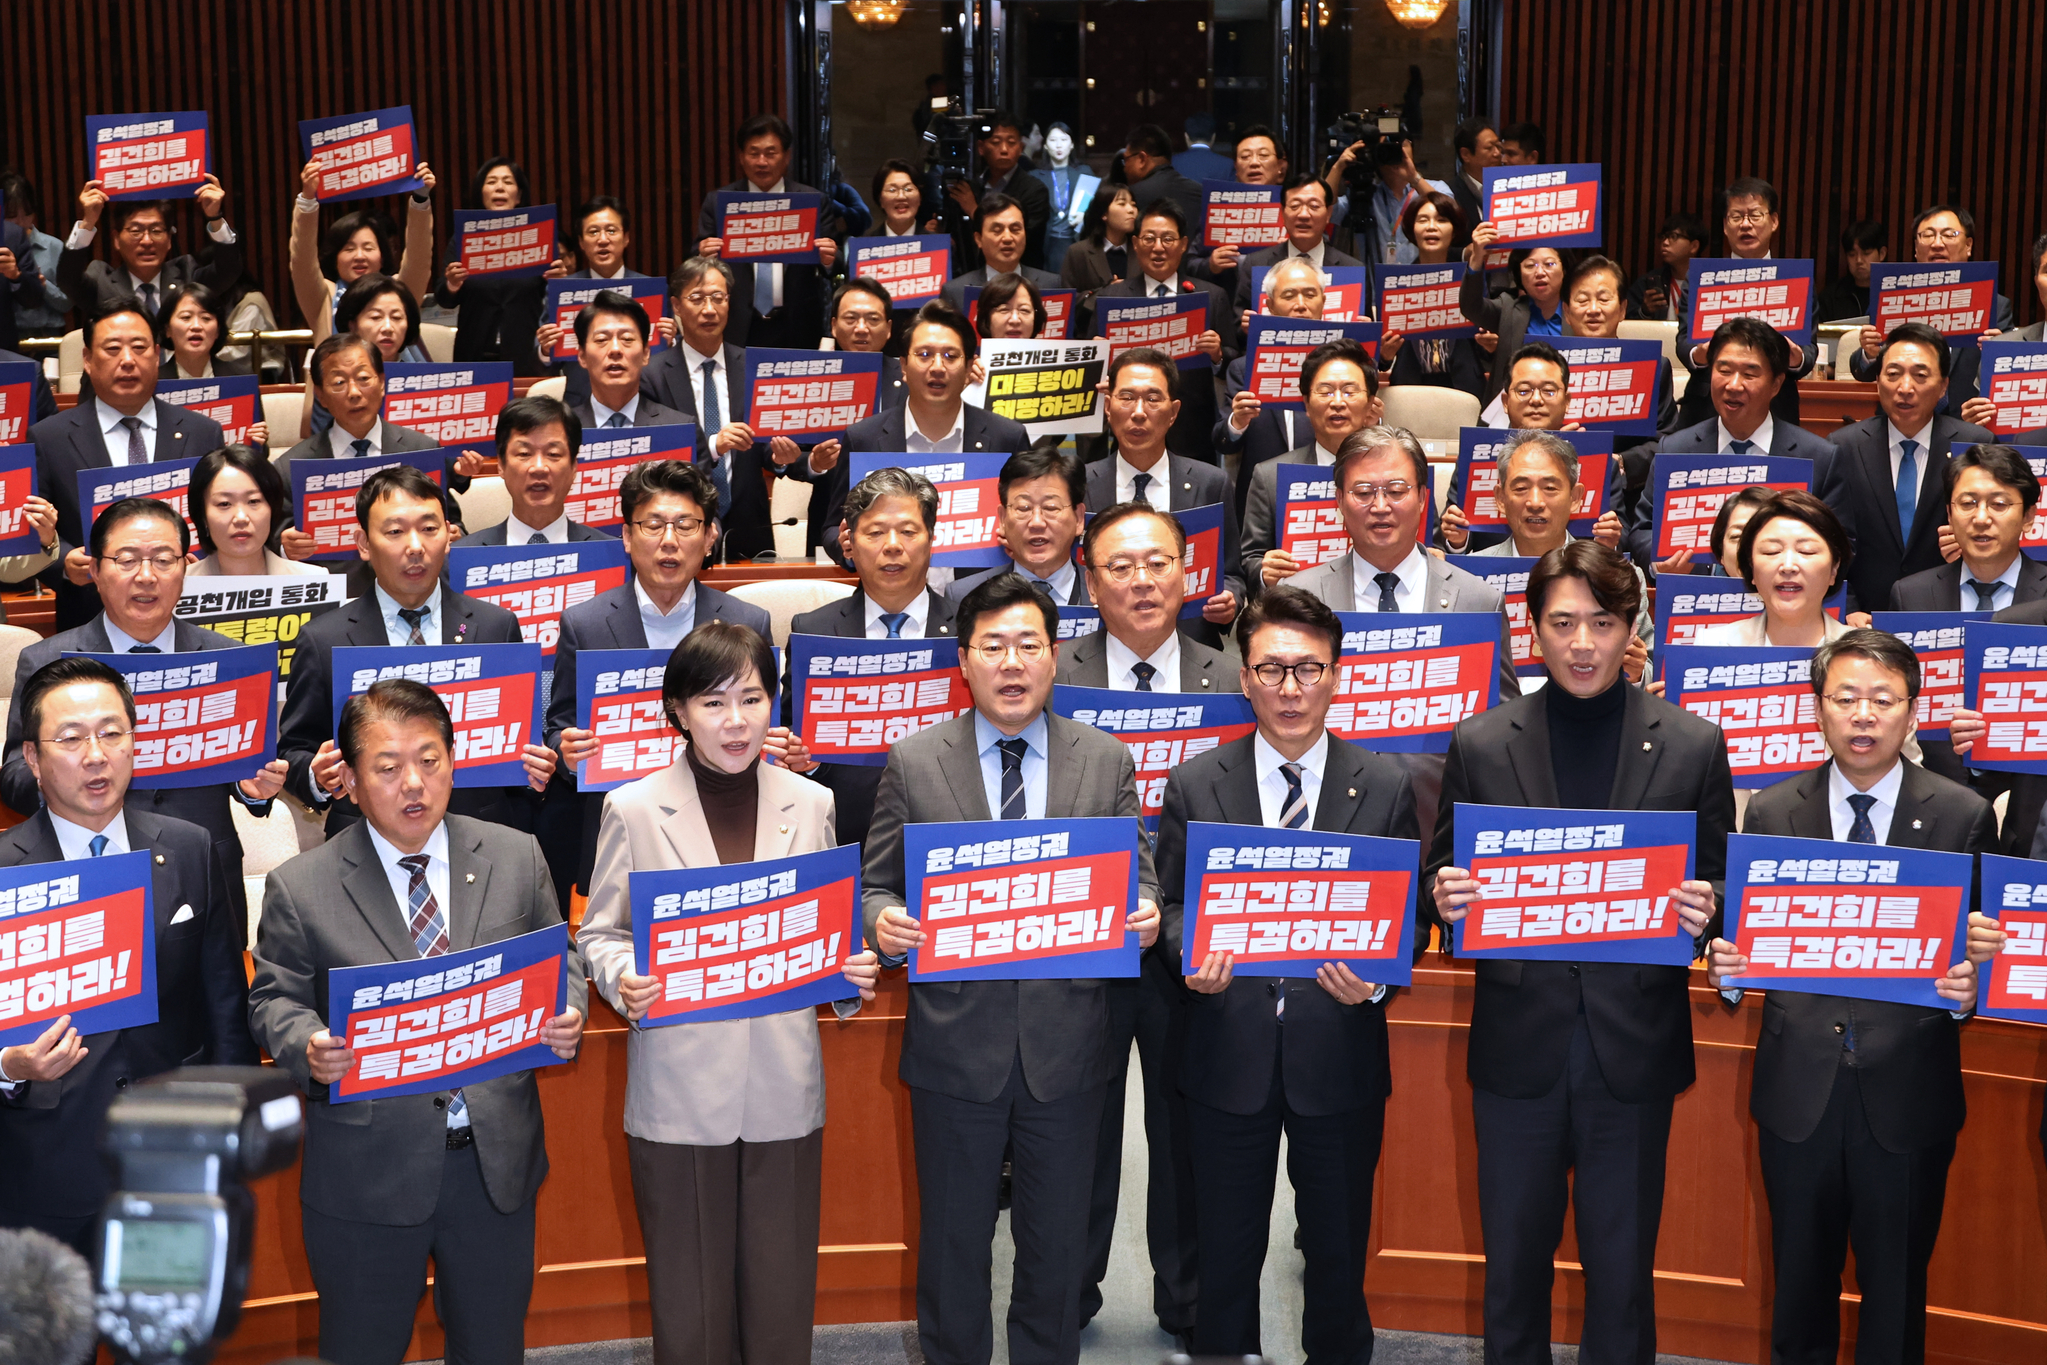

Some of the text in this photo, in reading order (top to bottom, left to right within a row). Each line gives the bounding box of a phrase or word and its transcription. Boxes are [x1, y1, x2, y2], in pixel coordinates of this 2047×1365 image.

[97, 120, 174, 142] 윤석열정권
[310, 118, 378, 146] 윤석열정권
[99, 138, 186, 169] 김건희를
[103, 159, 200, 190] 특검하라!
[322, 154, 407, 191] 특검하라!
[1493, 170, 1567, 192] 윤석열정권
[726, 199, 790, 213] 윤석열정권
[1209, 191, 1271, 203] 윤석열정권
[1494, 189, 1577, 217] 김건희를
[463, 214, 528, 232] 윤석열정권
[726, 214, 800, 235] 김건희를
[1209, 207, 1279, 224] 김건희를
[1497, 210, 1589, 238] 특검하라!
[464, 228, 538, 253] 김건희를
[729, 232, 809, 253] 특검하라!
[857, 241, 921, 260] 윤석열정권
[469, 244, 548, 270] 특검하라!
[880, 274, 942, 298] 검하라!
[1385, 269, 1453, 288] 윤석열정권
[1701, 266, 1777, 288] 윤석열정권
[1881, 270, 1961, 290] 윤석열정권
[1107, 302, 1177, 322] 윤석열정권
[1384, 287, 1460, 312] 김건희를
[1700, 285, 1788, 311] 김건희를
[1881, 288, 1972, 314] 김건희를
[1109, 317, 1187, 343] 김건희를
[1259, 329, 1343, 345] 윤석열정권
[757, 359, 842, 376] 윤석열정권
[990, 346, 1097, 367] 공천개입 통화
[388, 370, 473, 392] 윤석열정권
[756, 380, 854, 406] 김건희를
[989, 367, 1085, 396] 대통령이
[388, 391, 486, 421] 김건희를
[759, 403, 867, 430] 특검하라!
[992, 391, 1093, 420] 해명하라!
[94, 467, 190, 503] 윤석열정권
[1669, 466, 1768, 488] 윤석열정권
[466, 553, 578, 587] 윤석열정권
[176, 582, 328, 615] 공천개입 통화
[1341, 625, 1442, 652] 석열정권
[809, 649, 933, 675] 윤석열정권
[1683, 659, 1811, 689] 윤석열정권
[810, 677, 951, 713] 김건희를
[136, 689, 237, 732] 건희를
[133, 719, 257, 769] 검하라!
[926, 832, 1069, 873] 윤석열정권
[1474, 824, 1624, 854] 윤석열정권
[1206, 846, 1351, 870] 윤석열정권
[1747, 859, 1899, 883] 윤석열정권
[1477, 858, 1646, 899] 김건희를
[653, 868, 796, 919] 윤석열정권
[927, 866, 1091, 920] 김건희를
[1205, 880, 1371, 915] 김건희를
[1480, 896, 1670, 939] 특검하라!
[1745, 894, 1919, 929] 김건희를
[657, 899, 818, 965] 김건희를
[934, 905, 1115, 959] 특검하라!
[1209, 919, 1392, 955] 특검하라!
[665, 931, 841, 1001] 특검하라!
[1750, 935, 1942, 969] 특검하라!
[352, 953, 503, 1009] 윤석열정권
[352, 979, 523, 1049] 김건희를
[359, 1006, 545, 1080] 특검하라!
